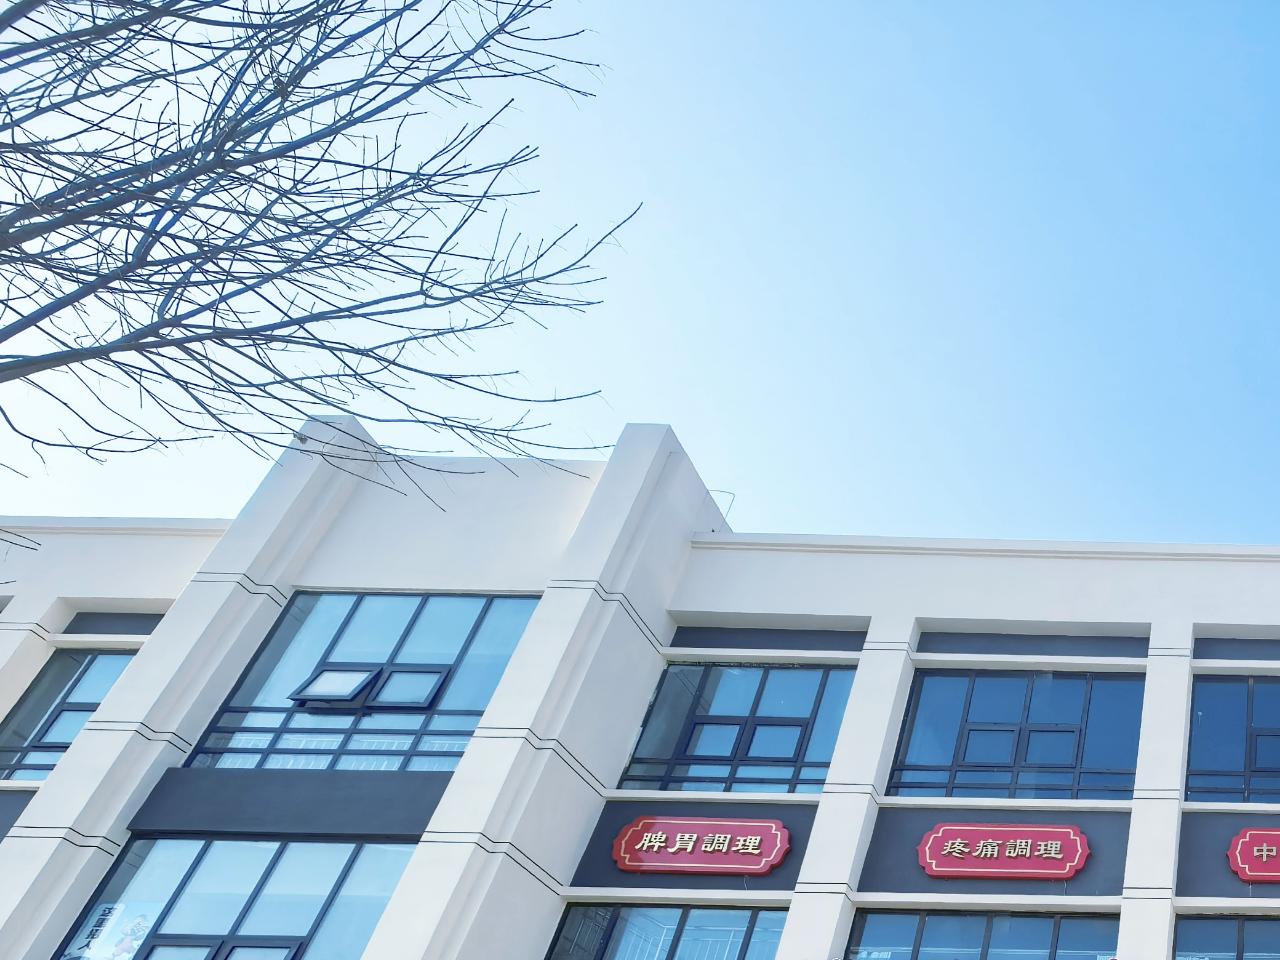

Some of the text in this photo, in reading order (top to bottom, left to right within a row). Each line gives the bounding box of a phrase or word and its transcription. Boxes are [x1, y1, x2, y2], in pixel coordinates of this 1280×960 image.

[635, 832, 762, 855] 脾胃調理
[941, 838, 1064, 859] 疼痛調理
